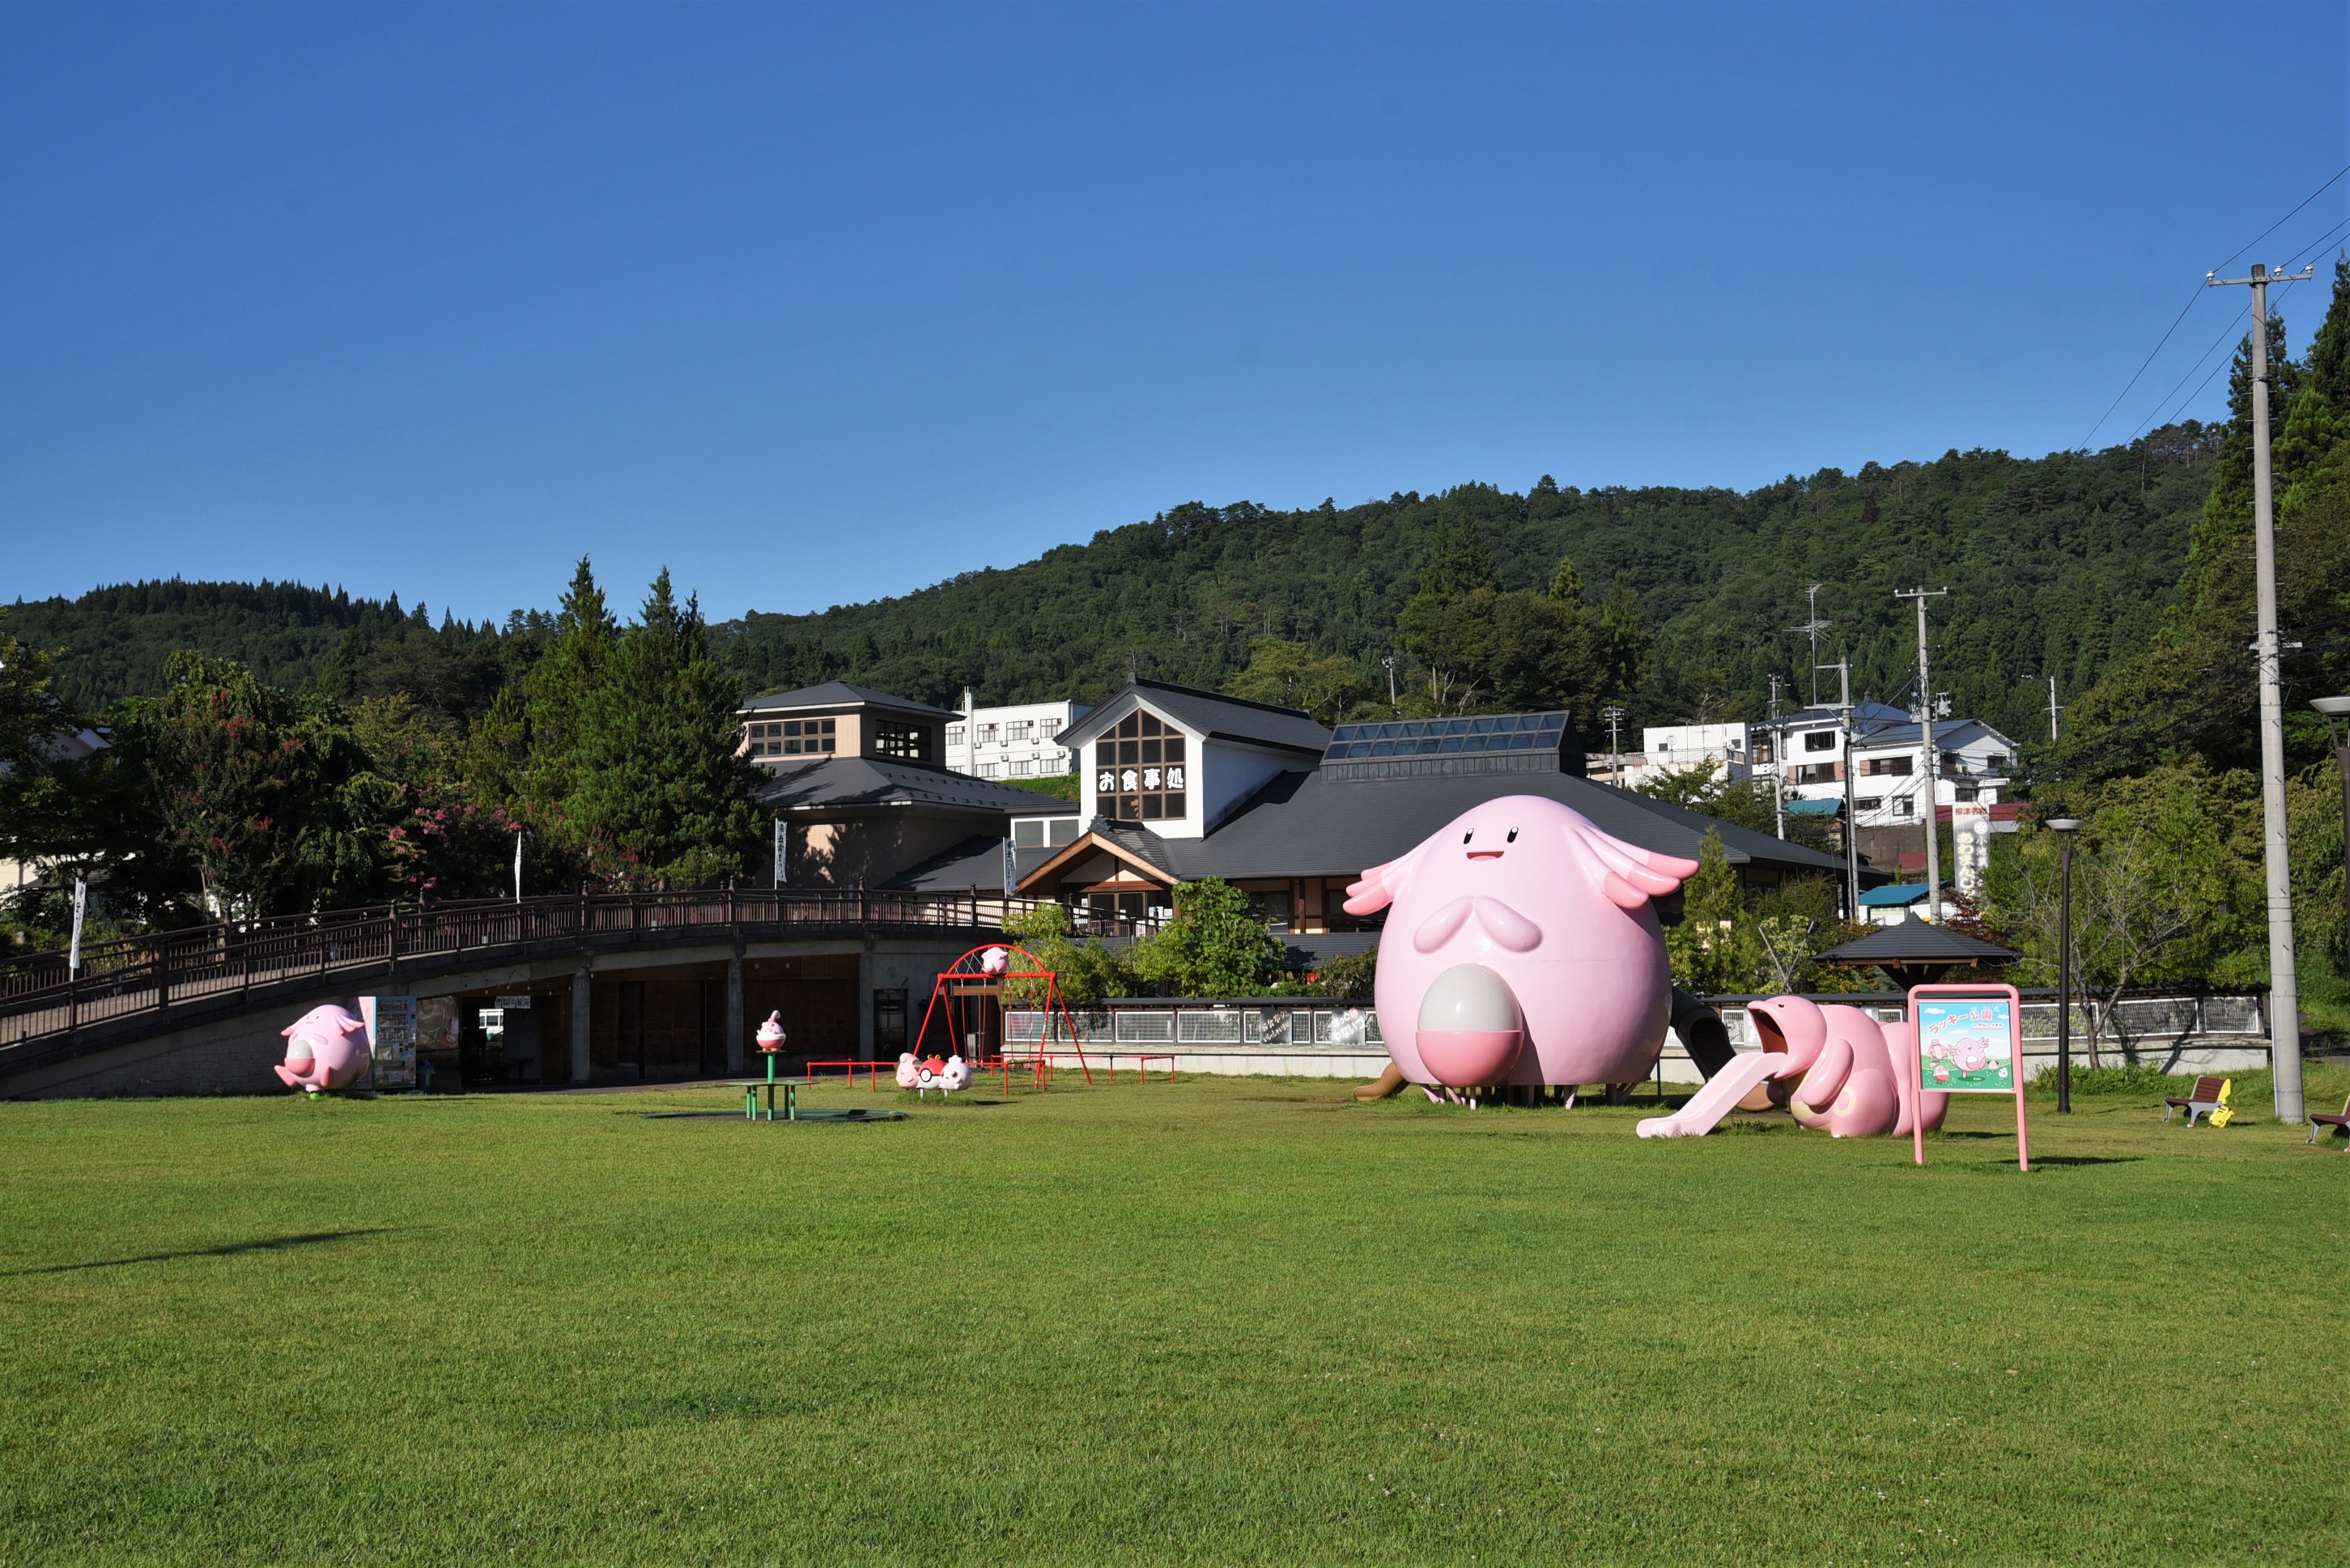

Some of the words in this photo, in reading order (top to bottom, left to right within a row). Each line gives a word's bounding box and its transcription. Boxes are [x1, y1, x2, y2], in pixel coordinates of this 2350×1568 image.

[1099, 767, 1184, 792] お食事処
[1332, 1015, 1365, 1043] やないづ
[1928, 1010, 1991, 1035] ラッキー公園
